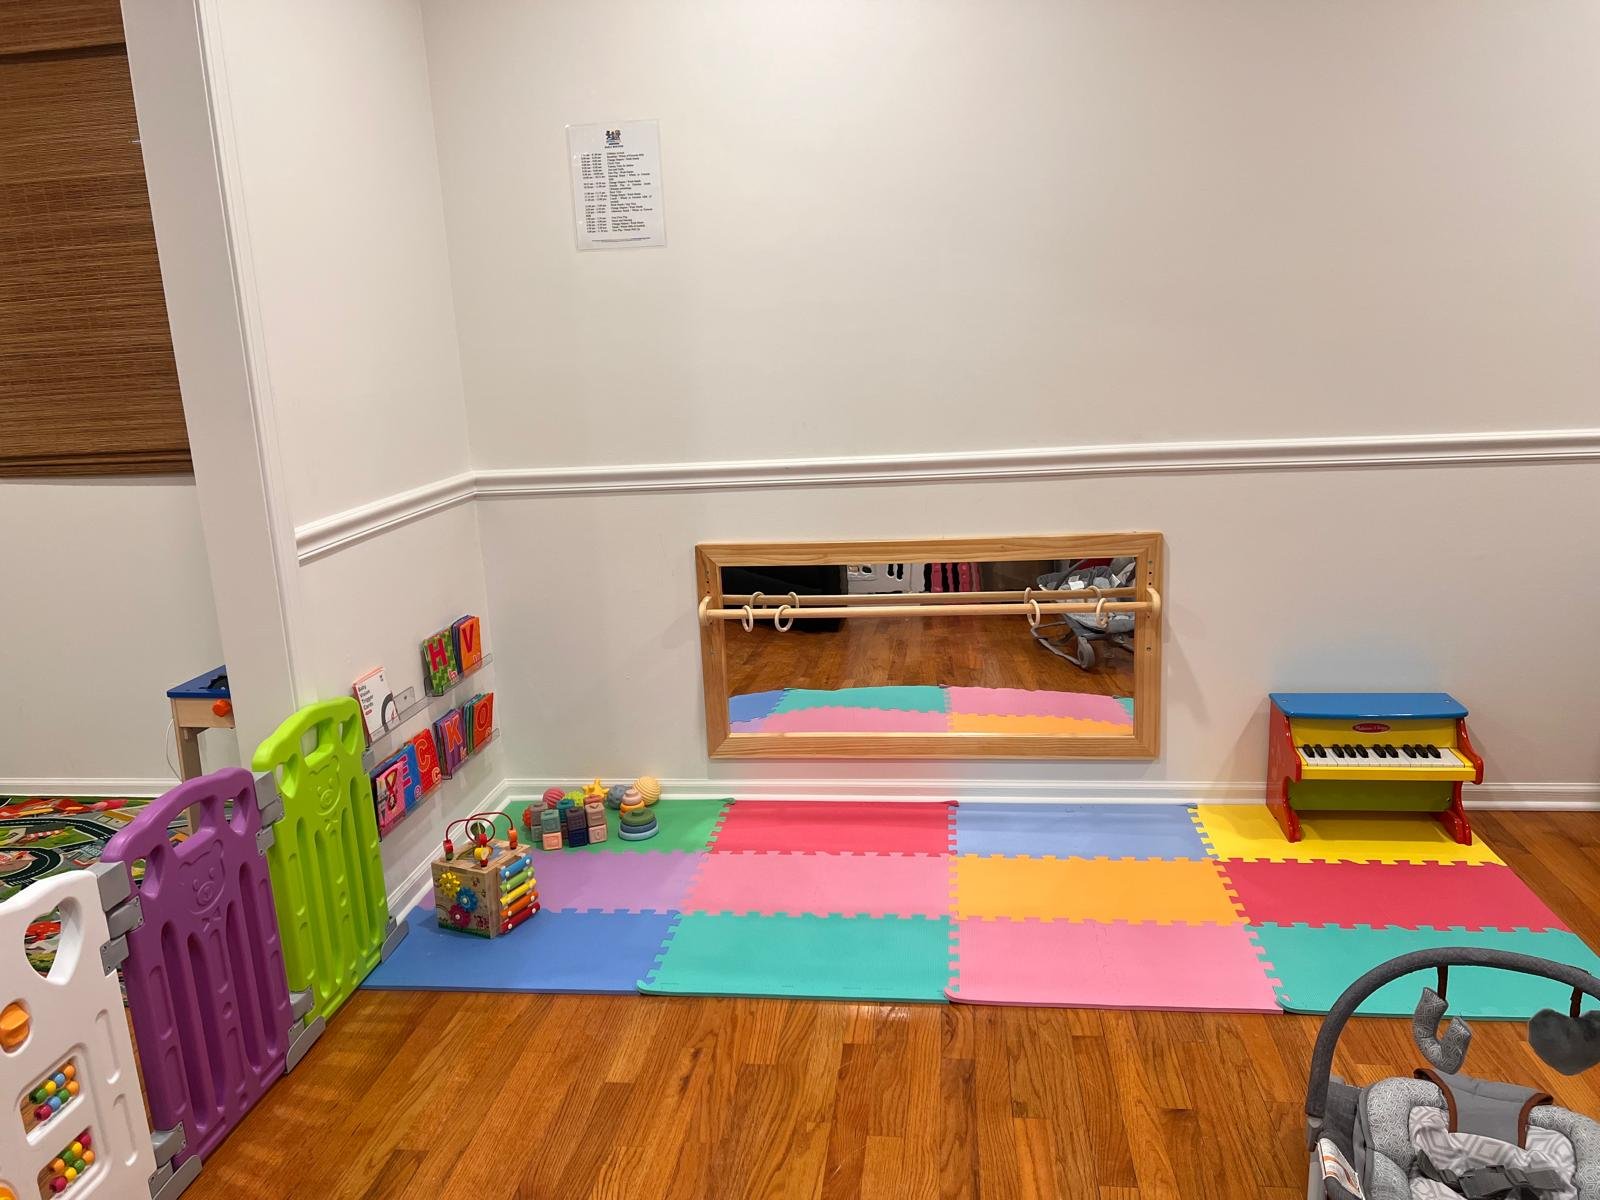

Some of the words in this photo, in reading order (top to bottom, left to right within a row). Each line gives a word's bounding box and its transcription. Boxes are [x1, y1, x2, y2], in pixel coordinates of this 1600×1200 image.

[461, 623, 474, 653] V
[427, 637, 448, 673] H
[476, 700, 489, 731] O
[445, 713, 462, 753] K
[415, 738, 431, 773] C
[431, 766, 441, 784] c
